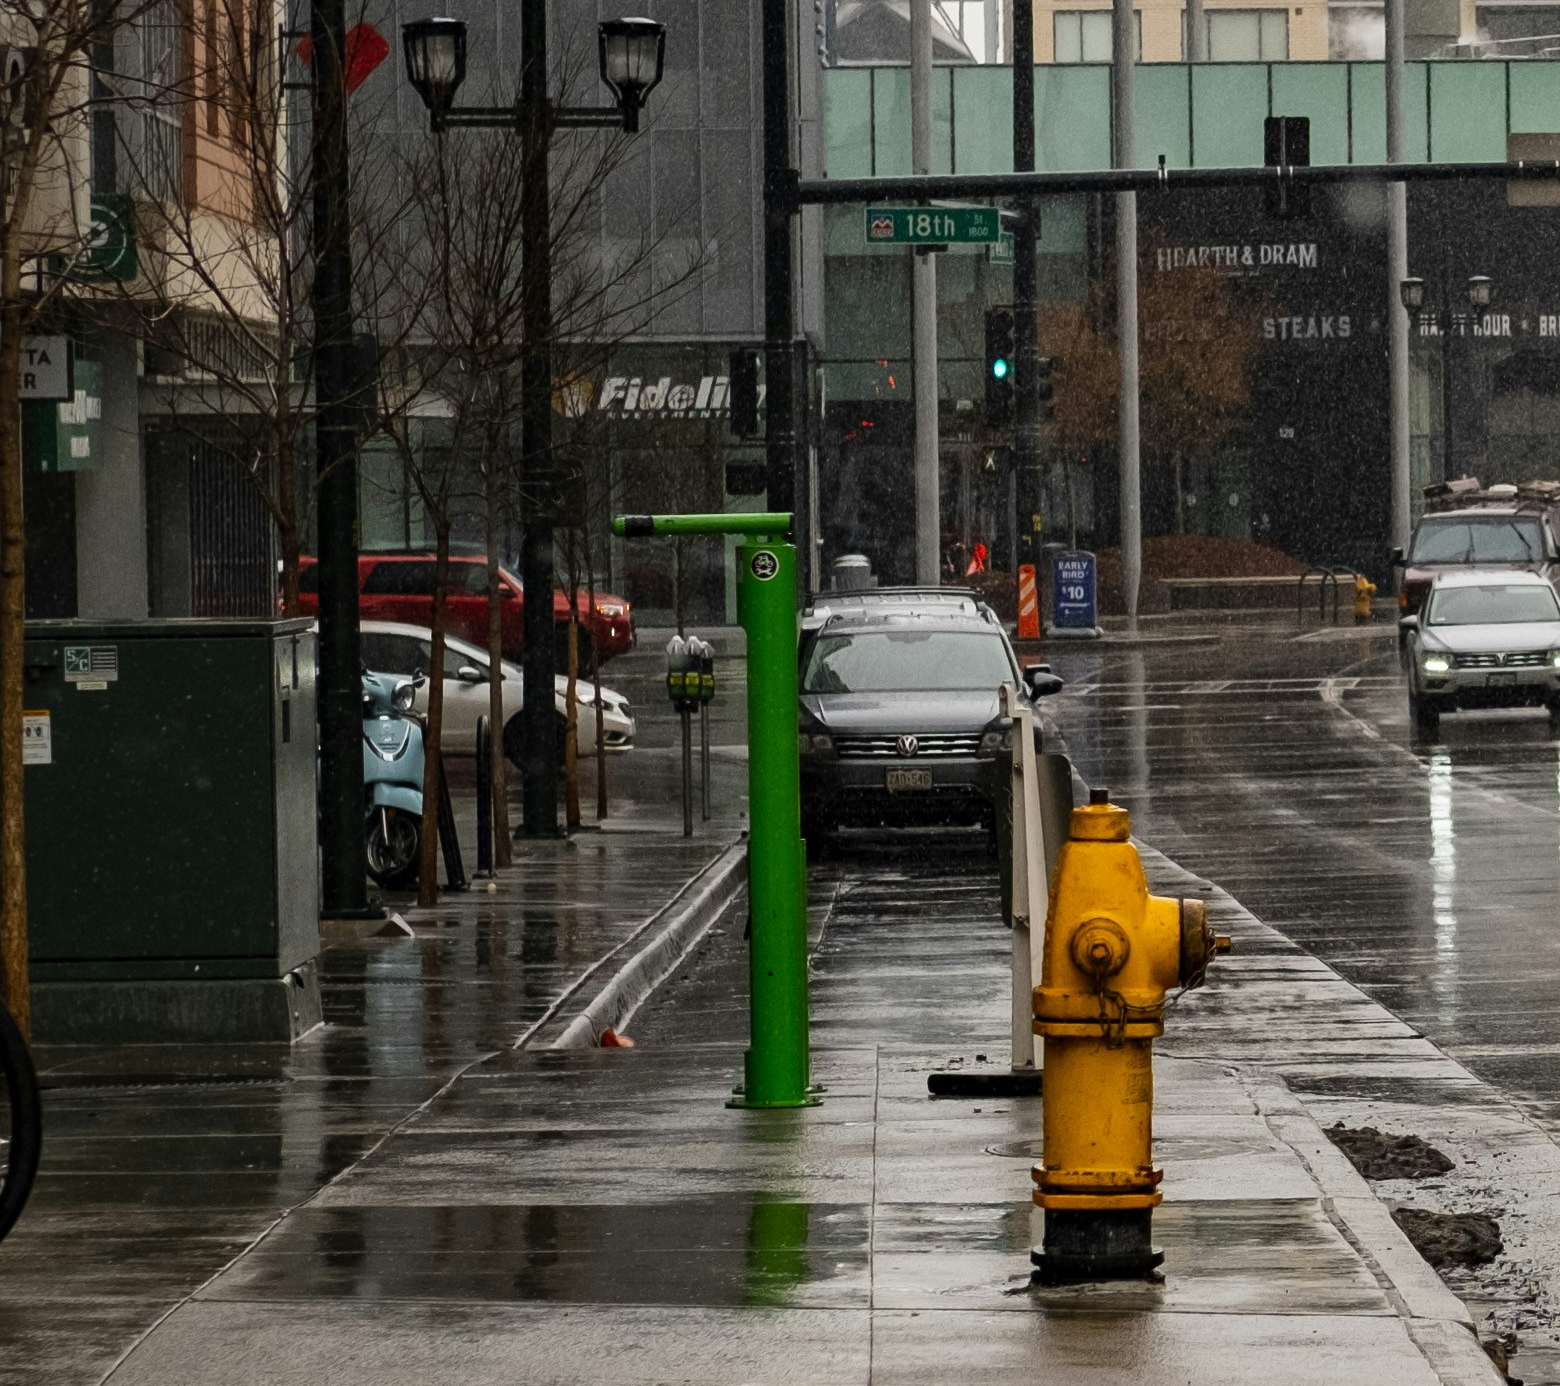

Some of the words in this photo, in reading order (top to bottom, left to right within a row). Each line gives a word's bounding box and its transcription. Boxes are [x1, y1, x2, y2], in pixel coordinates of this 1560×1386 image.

[906, 214, 955, 237] 18th
[968, 226, 989, 237] 1800
[1157, 245, 1240, 271] HEARTH
[1241, 245, 1255, 265] &
[1260, 243, 1317, 268] DRAM
[1262, 315, 1351, 340] STEAKS
[597, 376, 766, 411] Fideli
[1058, 561, 1088, 570] EARLY
[1062, 570, 1085, 579] BIRD
[1062, 586, 1084, 600] $10
